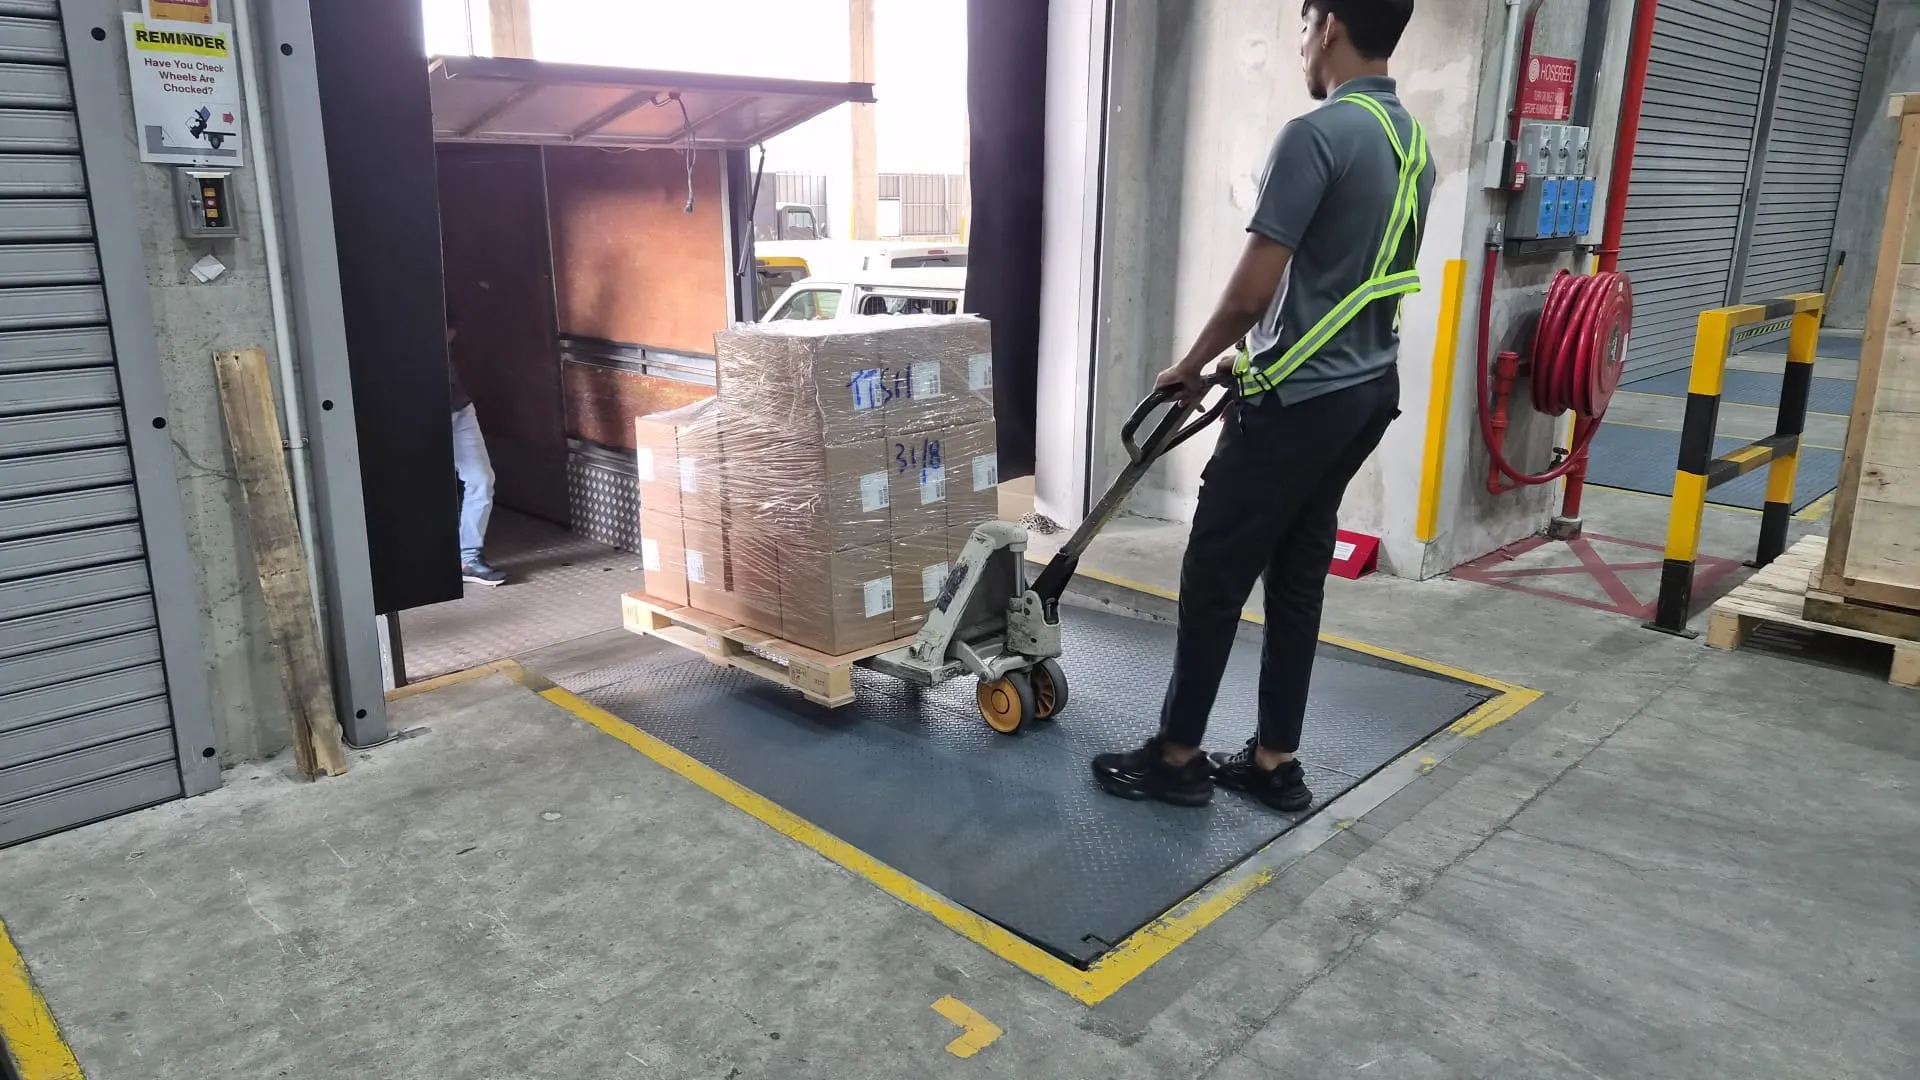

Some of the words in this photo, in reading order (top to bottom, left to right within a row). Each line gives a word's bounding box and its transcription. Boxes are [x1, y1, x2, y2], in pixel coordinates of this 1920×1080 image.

[136, 30, 226, 50] REMINDER
[144, 57, 171, 68] Have
[174, 59, 193, 70] You
[195, 62, 224, 73] Check
[158, 70, 197, 82] Wheels
[199, 74, 215, 83] Are
[163, 83, 214, 95] Chocked?
[895, 438, 941, 484] 31/8
